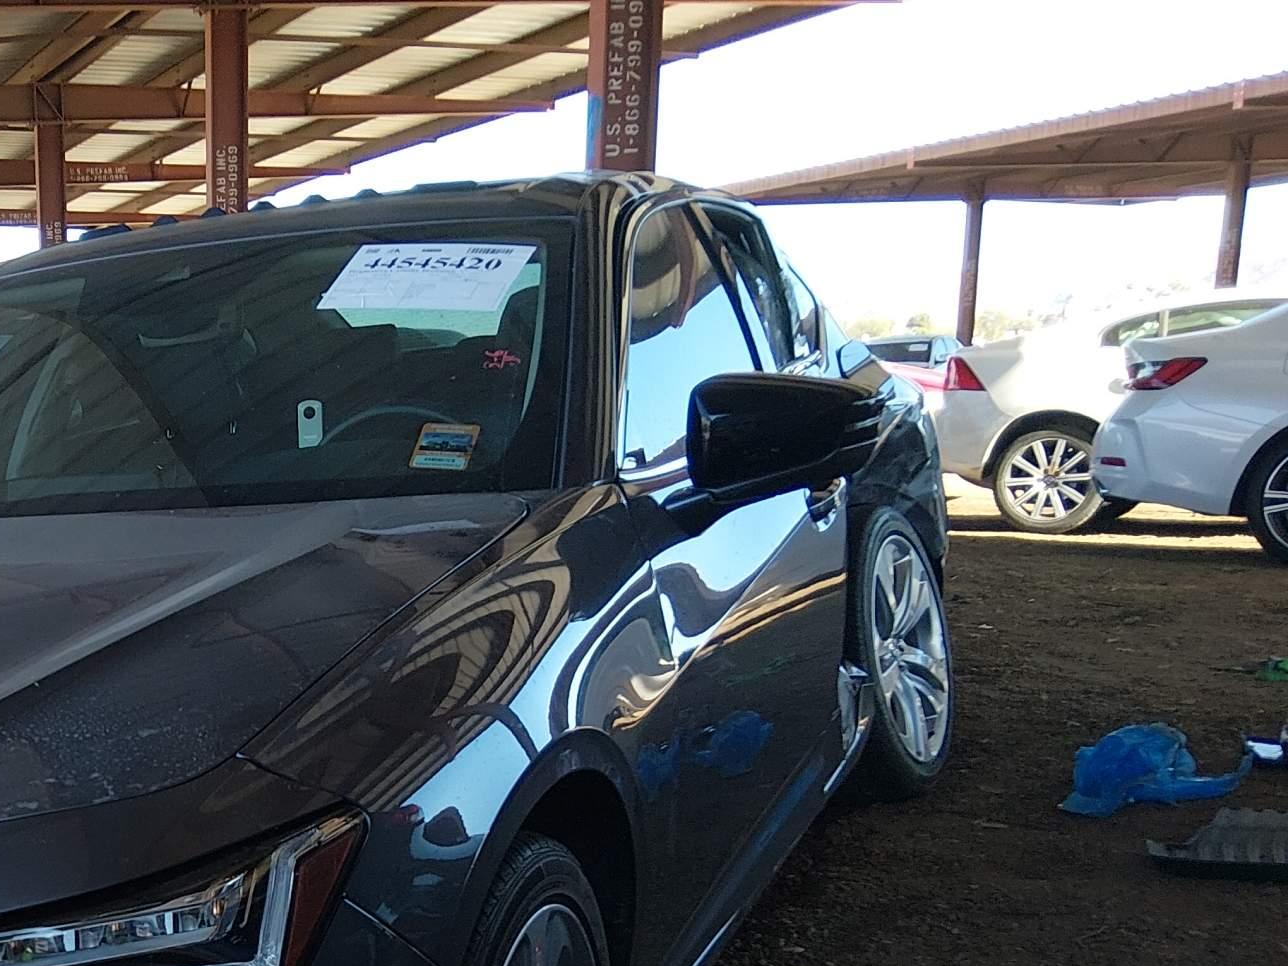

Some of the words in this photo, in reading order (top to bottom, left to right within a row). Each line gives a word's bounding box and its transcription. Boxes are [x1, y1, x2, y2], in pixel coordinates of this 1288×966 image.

[607, 21, 625, 105] PREFAB
[605, 116, 622, 158] U.S.
[215, 144, 227, 171] INC.
[363, 256, 503, 271] 44545420
